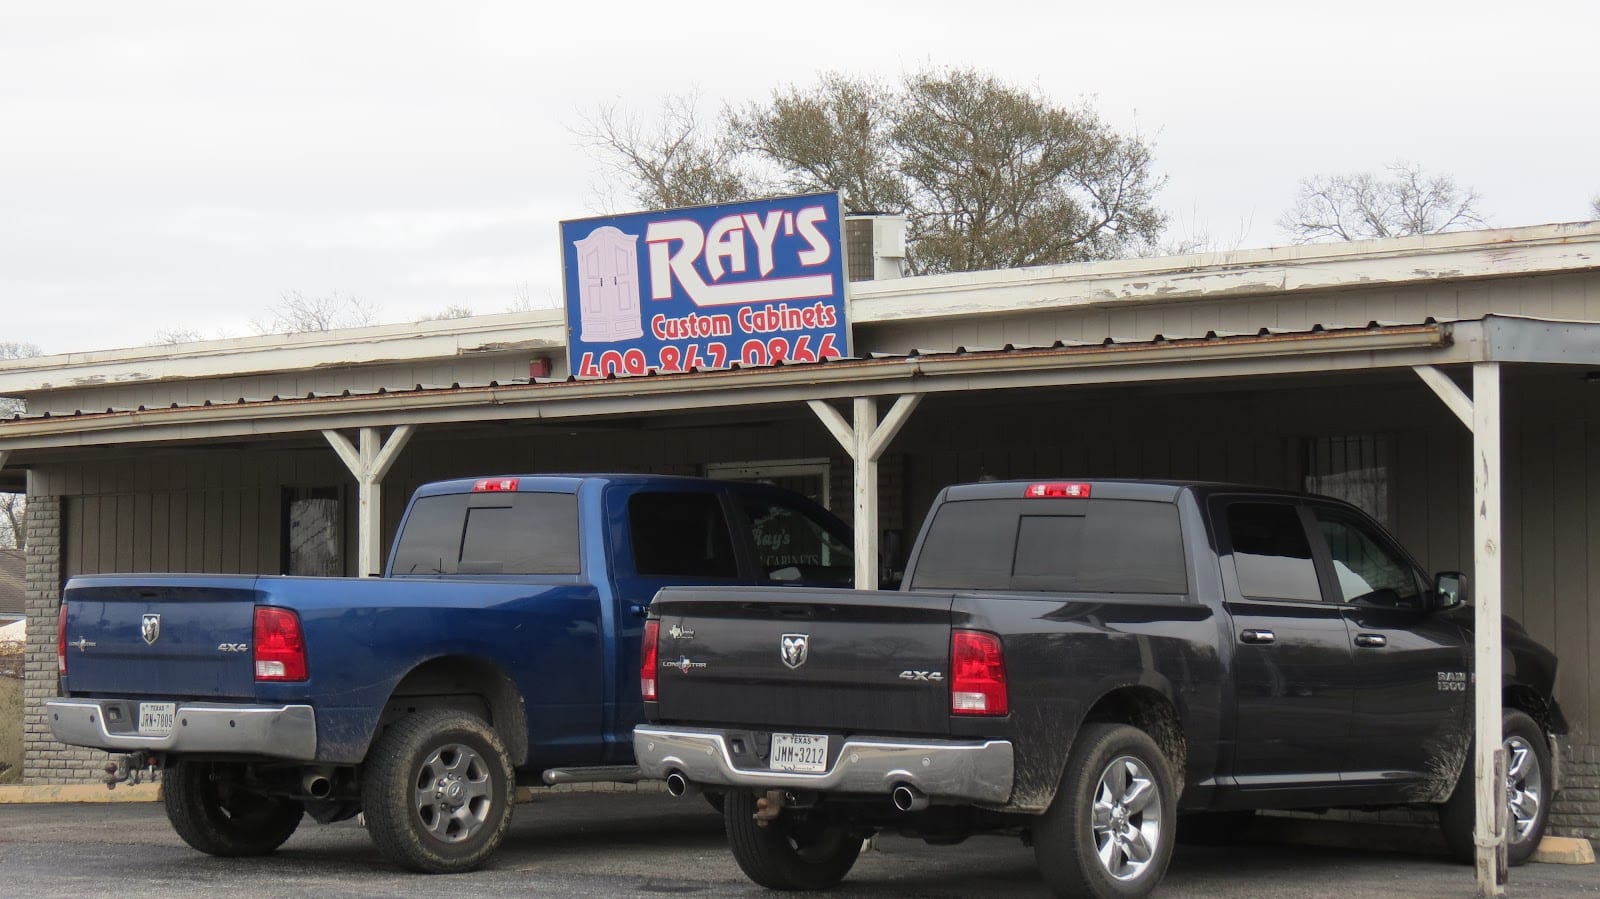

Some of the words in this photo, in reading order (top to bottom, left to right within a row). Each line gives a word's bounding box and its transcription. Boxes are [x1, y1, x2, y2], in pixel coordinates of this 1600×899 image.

[646, 206, 833, 306] RAY'S
[652, 312, 732, 340] Custom
[738, 302, 837, 333] Cabinets
[1437, 671, 1466, 681] RAM
[1437, 681, 1466, 691] 1500
